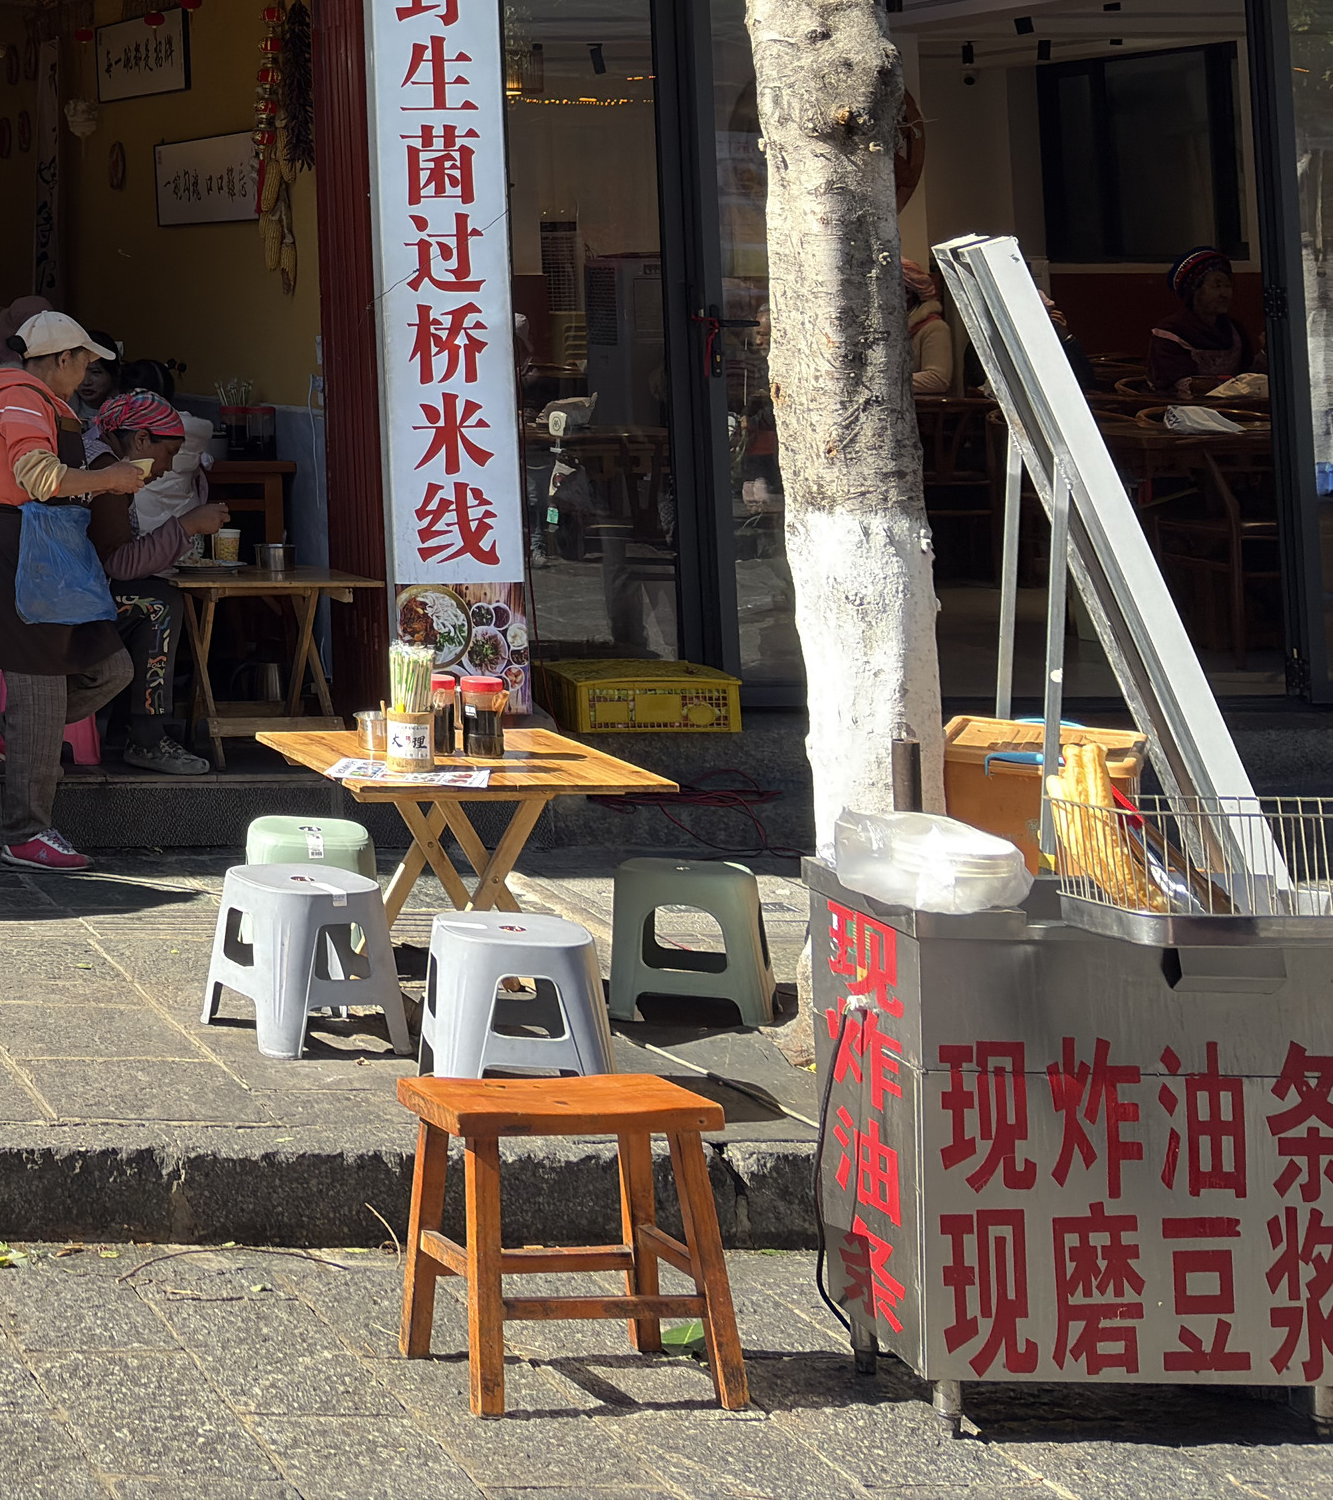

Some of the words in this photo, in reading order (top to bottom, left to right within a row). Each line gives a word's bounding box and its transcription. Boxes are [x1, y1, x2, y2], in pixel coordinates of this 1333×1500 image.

[824, 898, 908, 1335] 现炸油条
[937, 1036, 1333, 1205] 现炸油条
